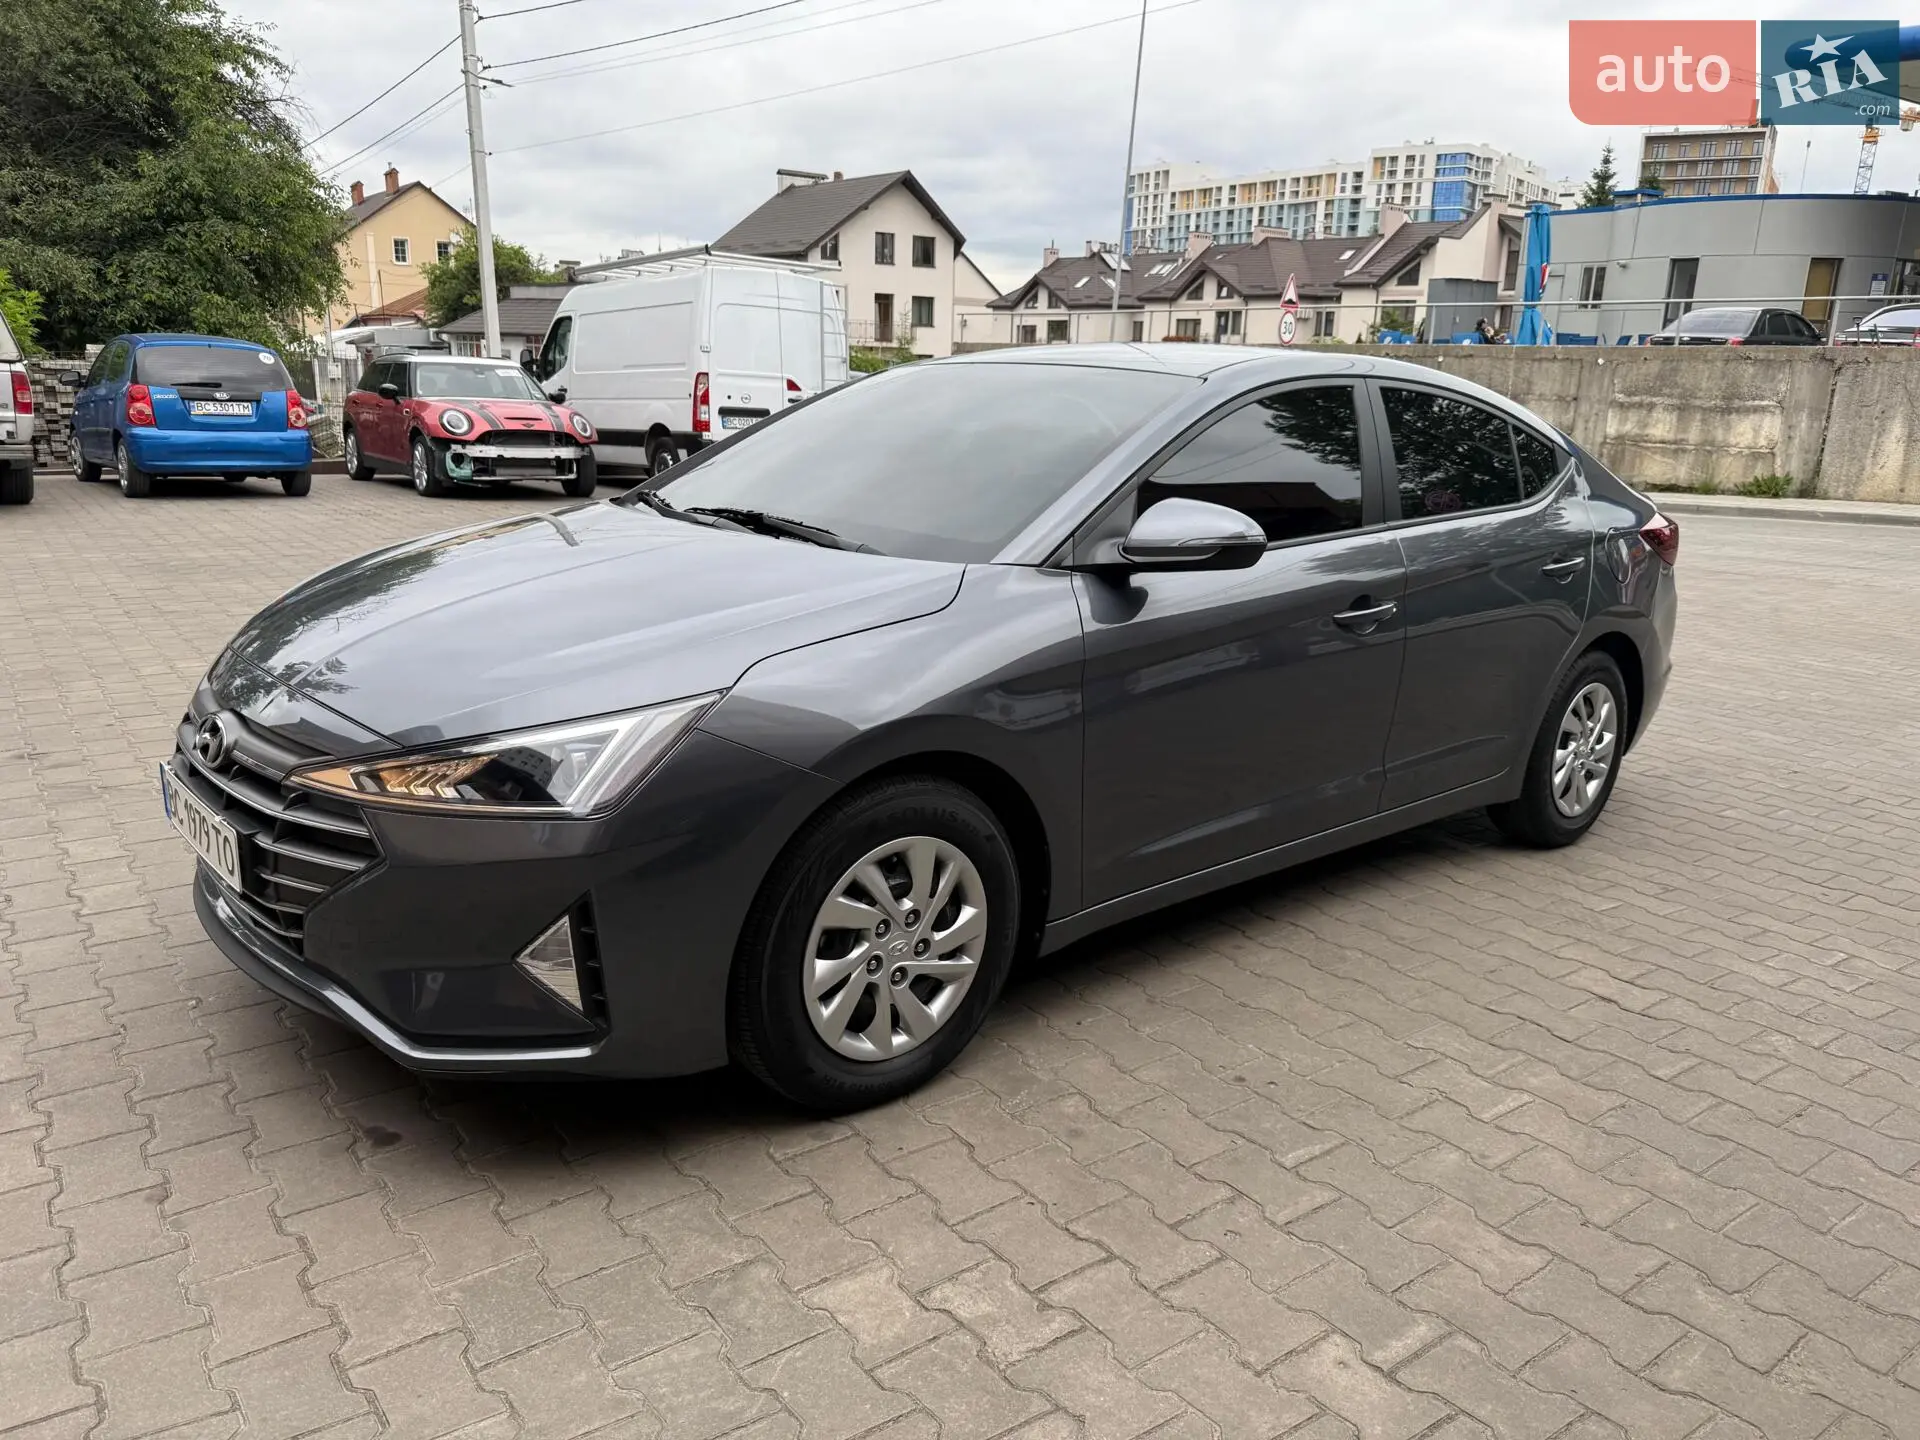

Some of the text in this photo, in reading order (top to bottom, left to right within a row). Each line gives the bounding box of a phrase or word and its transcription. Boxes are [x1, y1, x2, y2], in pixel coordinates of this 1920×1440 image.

[1282, 321, 1293, 335] 30
[212, 402, 235, 412] 5301
[184, 797, 210, 855] 1979
[211, 822, 235, 877] TO
